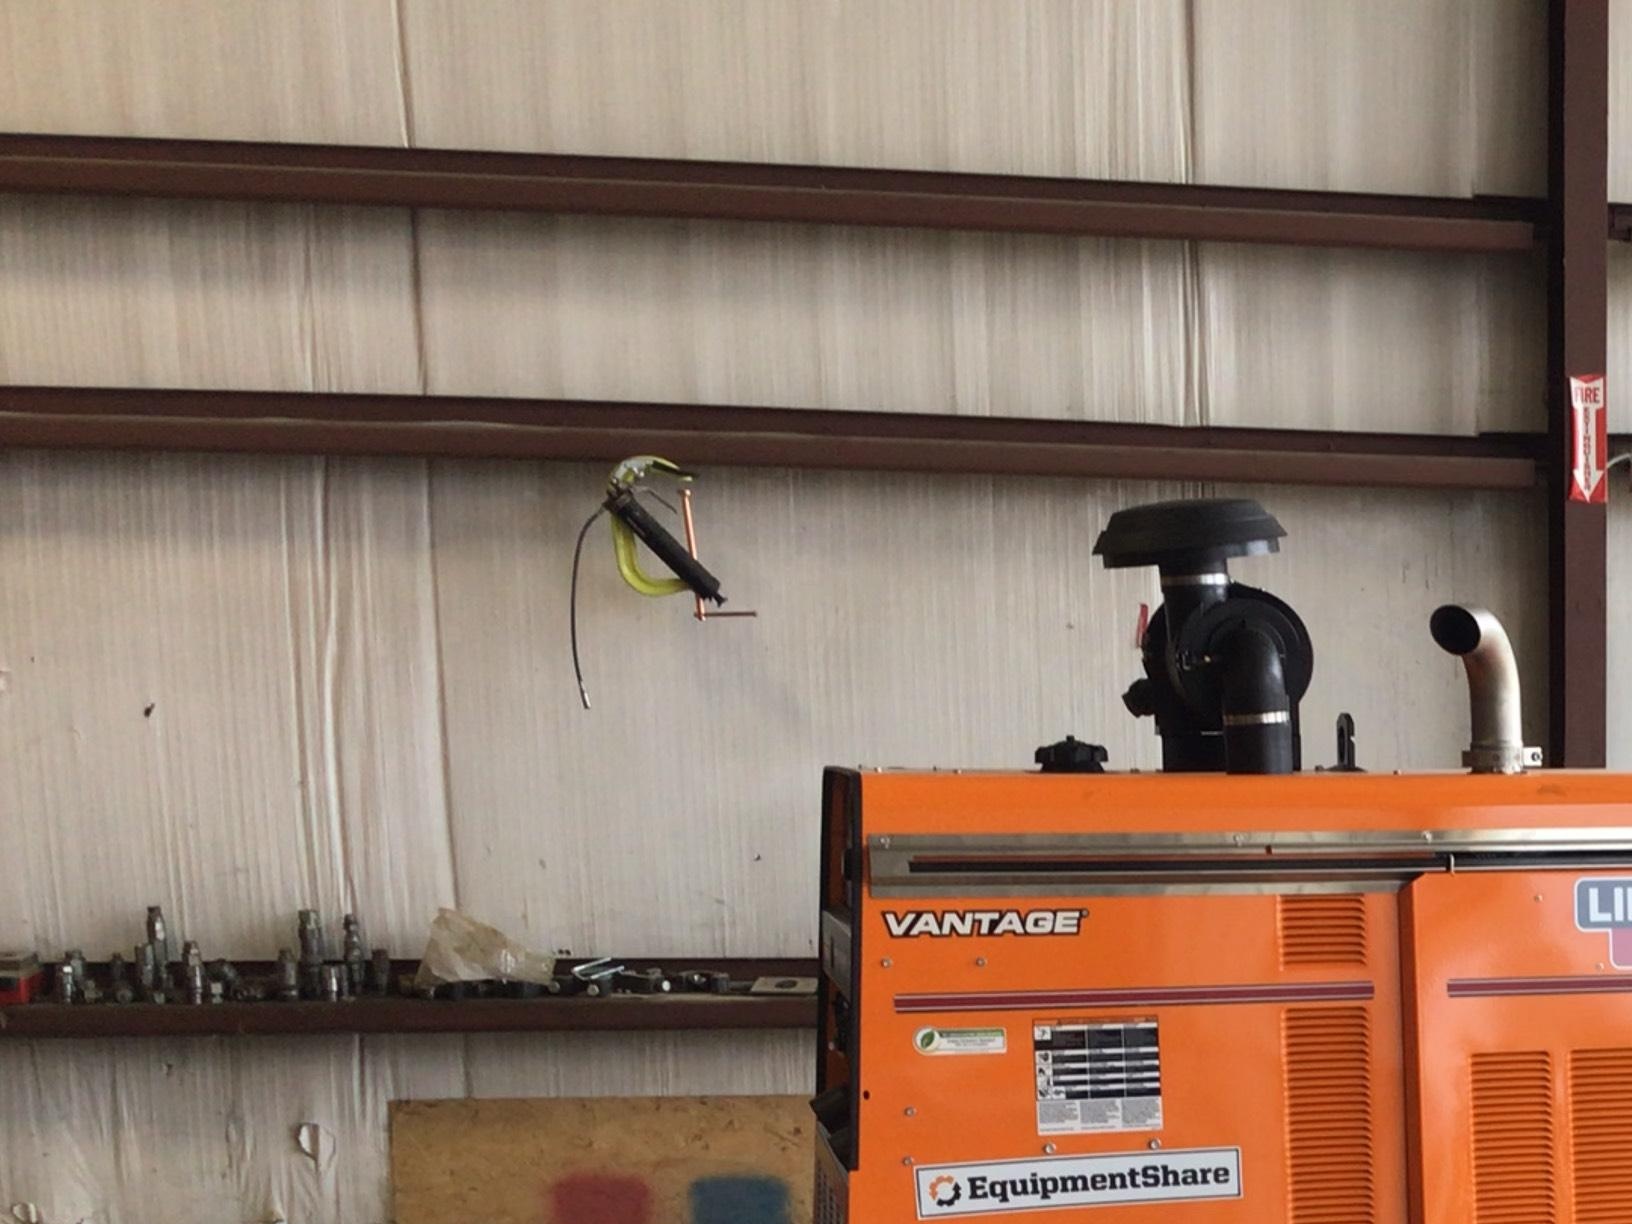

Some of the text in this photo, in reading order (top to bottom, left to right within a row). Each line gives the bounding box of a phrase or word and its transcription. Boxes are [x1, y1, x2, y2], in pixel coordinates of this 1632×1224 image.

[1574, 386, 1600, 404] FIRE
[883, 909, 1081, 937] VANTAGE
[967, 1164, 1231, 1203] EquipmentShare
